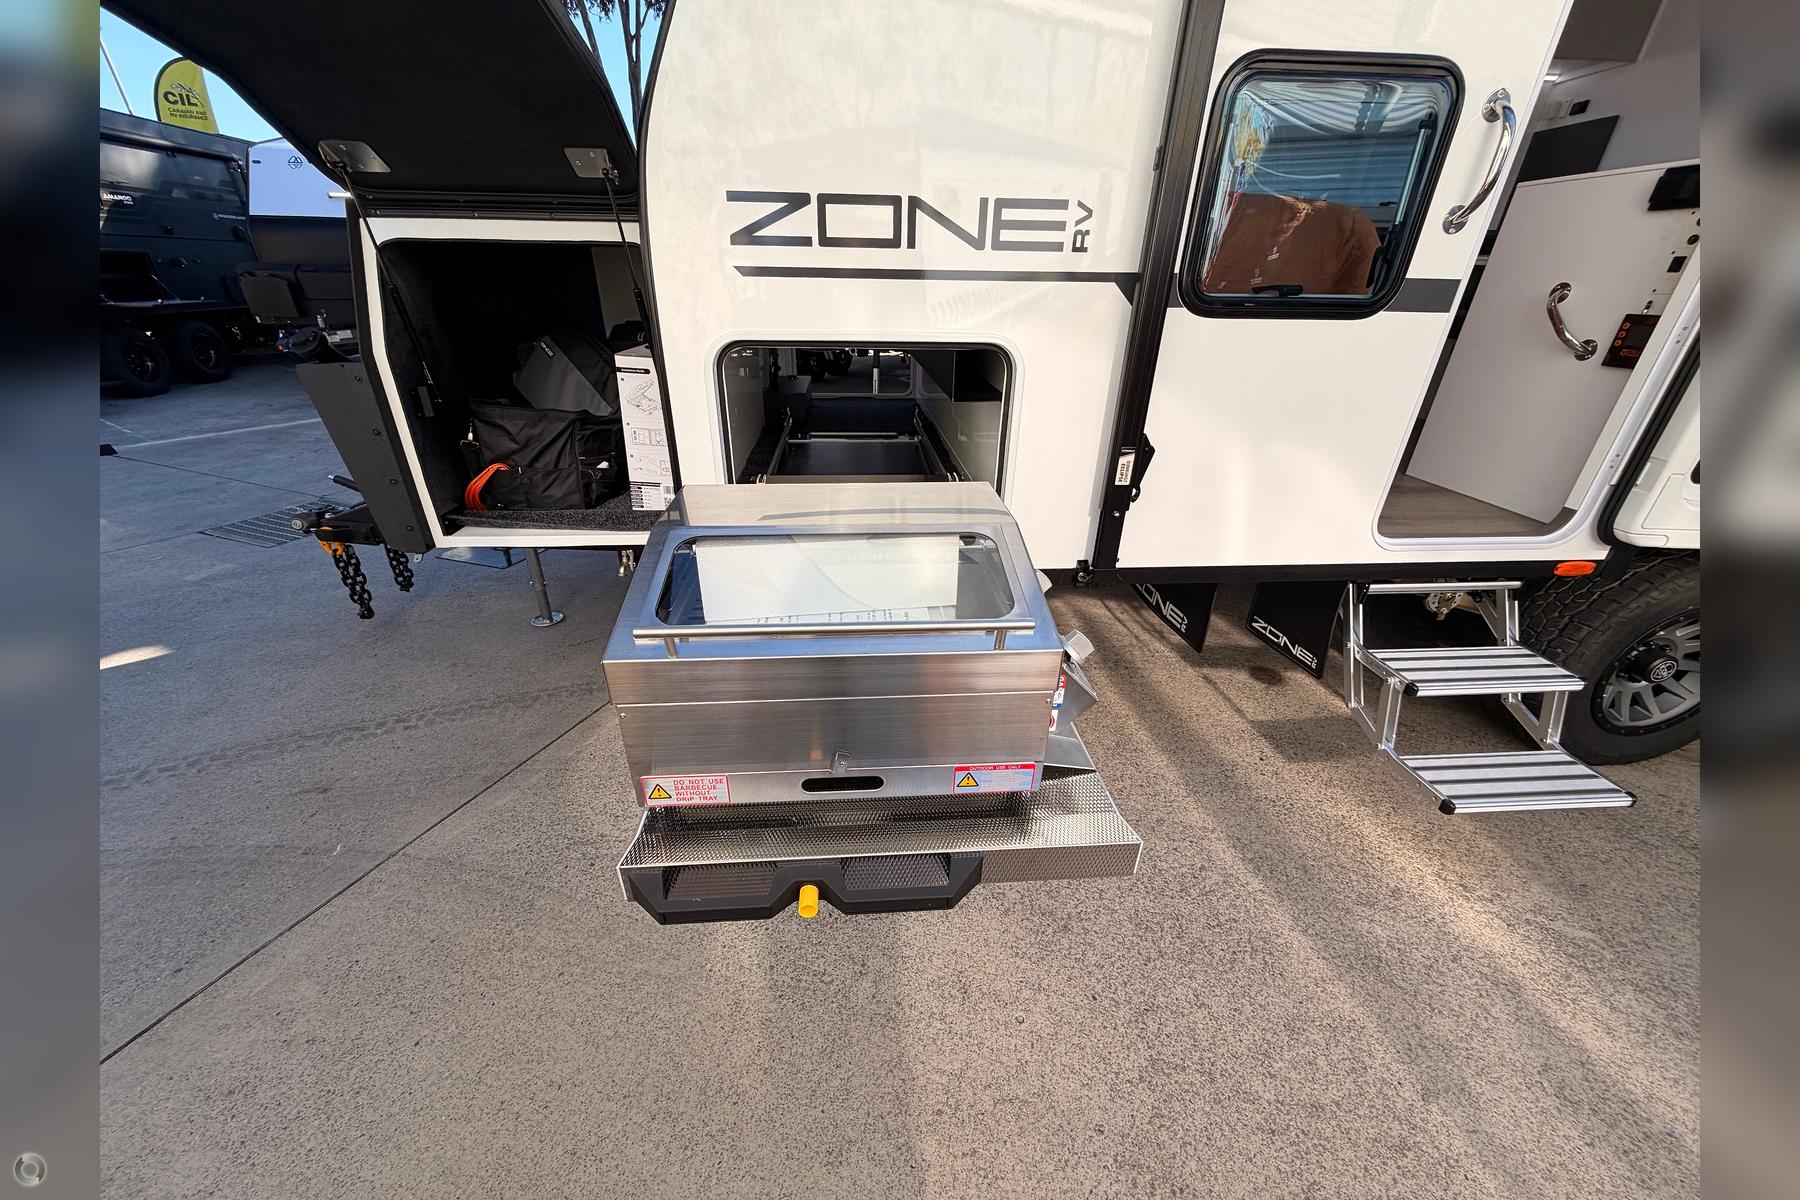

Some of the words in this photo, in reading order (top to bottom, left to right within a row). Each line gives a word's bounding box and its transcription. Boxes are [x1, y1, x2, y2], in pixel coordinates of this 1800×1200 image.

[163, 91, 198, 107] CIL
[178, 113, 209, 121] INSURANCE
[726, 190, 1069, 253] ZONE
[1071, 199, 1094, 254] RV
[1251, 622, 1313, 666] ZONE
[1311, 656, 1318, 669] RV
